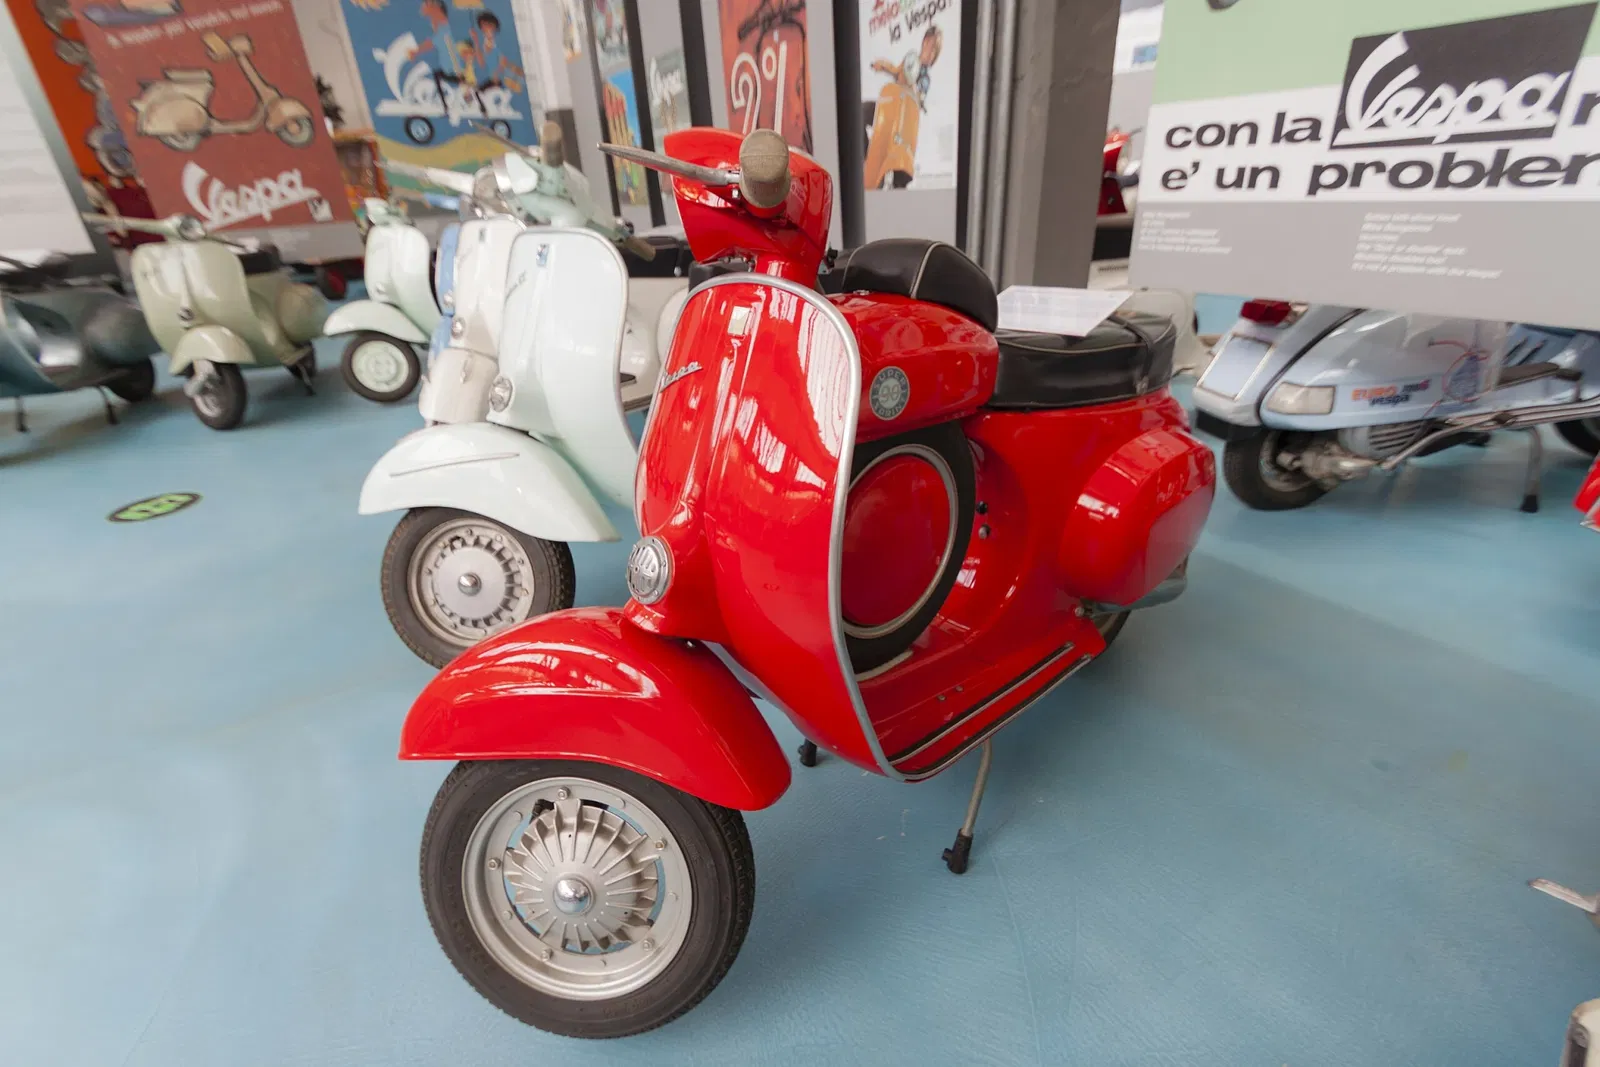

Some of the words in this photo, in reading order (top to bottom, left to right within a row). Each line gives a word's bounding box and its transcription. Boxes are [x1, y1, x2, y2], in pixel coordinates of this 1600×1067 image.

[372, 31, 523, 127] Vespa
[1165, 122, 1259, 148] con
[1271, 111, 1323, 143] la
[1332, 31, 1571, 144] Vespa
[182, 160, 321, 231] Vespa
[1215, 164, 1280, 189] un
